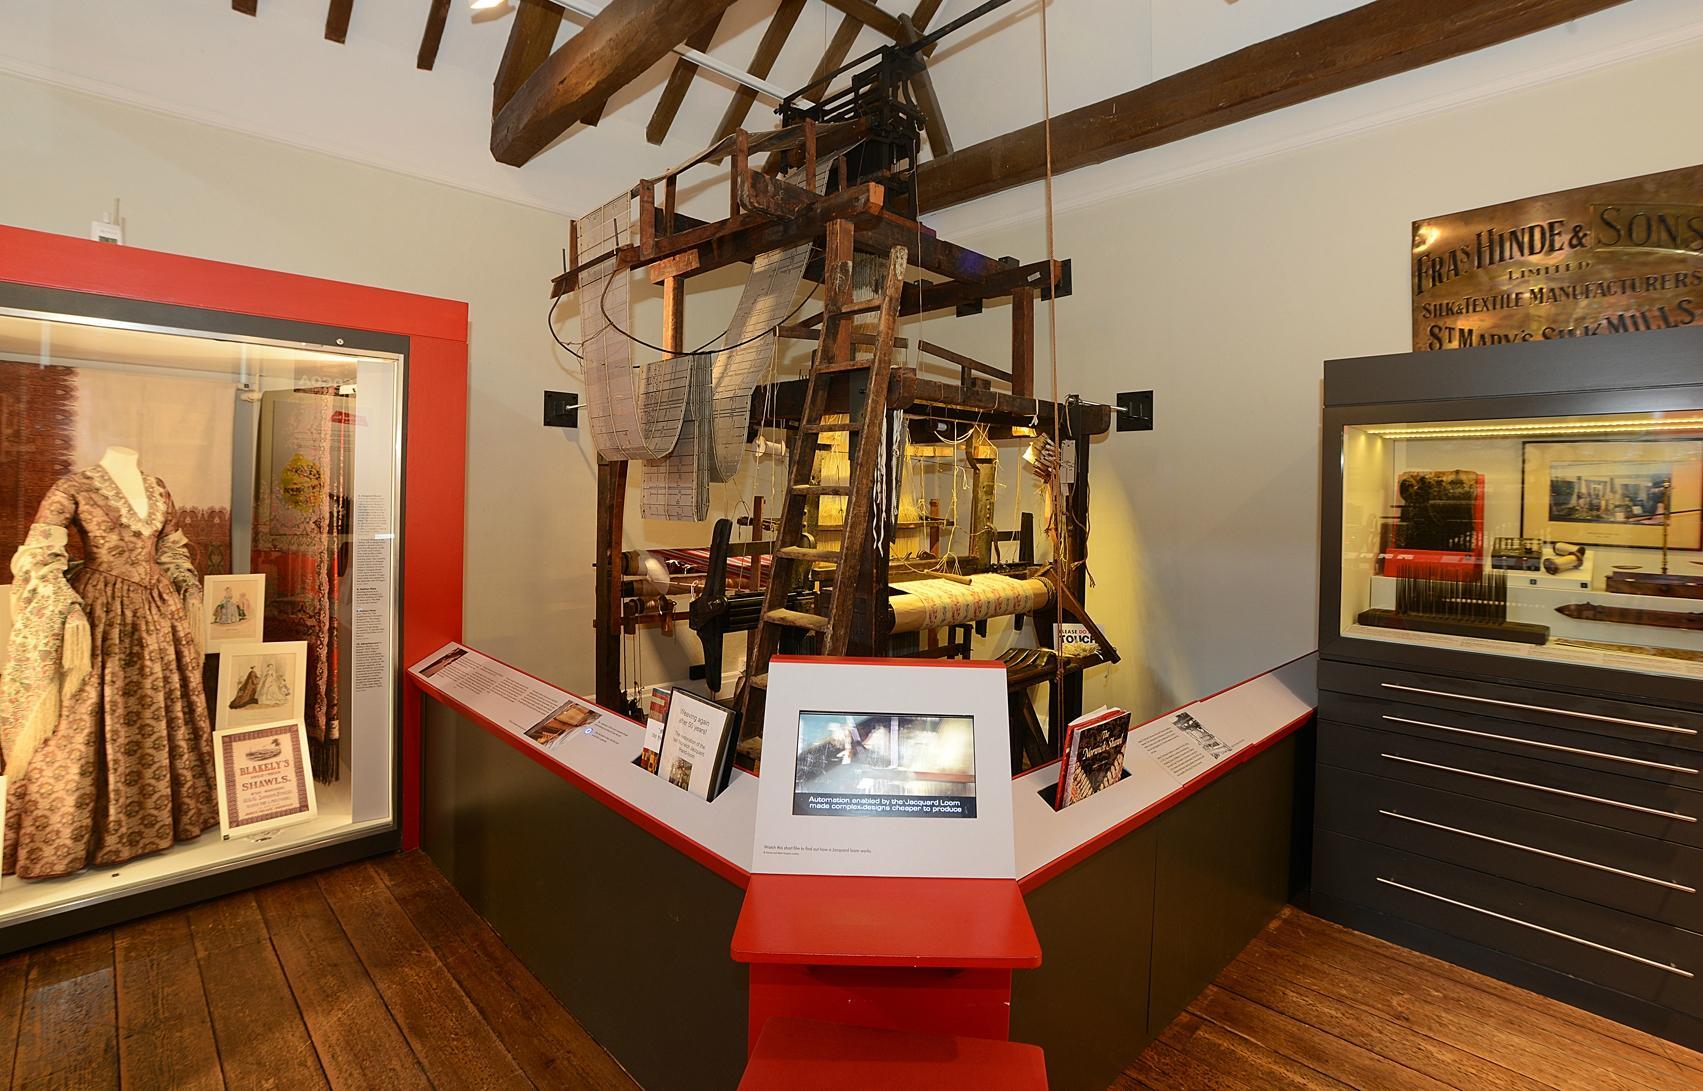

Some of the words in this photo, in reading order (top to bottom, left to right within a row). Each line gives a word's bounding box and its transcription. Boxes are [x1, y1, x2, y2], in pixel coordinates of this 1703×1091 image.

[1475, 219, 1566, 270] HINDE
[1507, 259, 1592, 281] LIMITED
[1528, 269, 1703, 306] MANUFACTURERS
[1602, 298, 1697, 334] MILLS
[240, 760, 290, 776] BLAKELY'S
[808, 795, 850, 804] Automation
[881, 798, 890, 806] by
[904, 799, 939, 807] Jacquard
[863, 804, 891, 812] designs
[892, 805, 922, 813] cheaper
